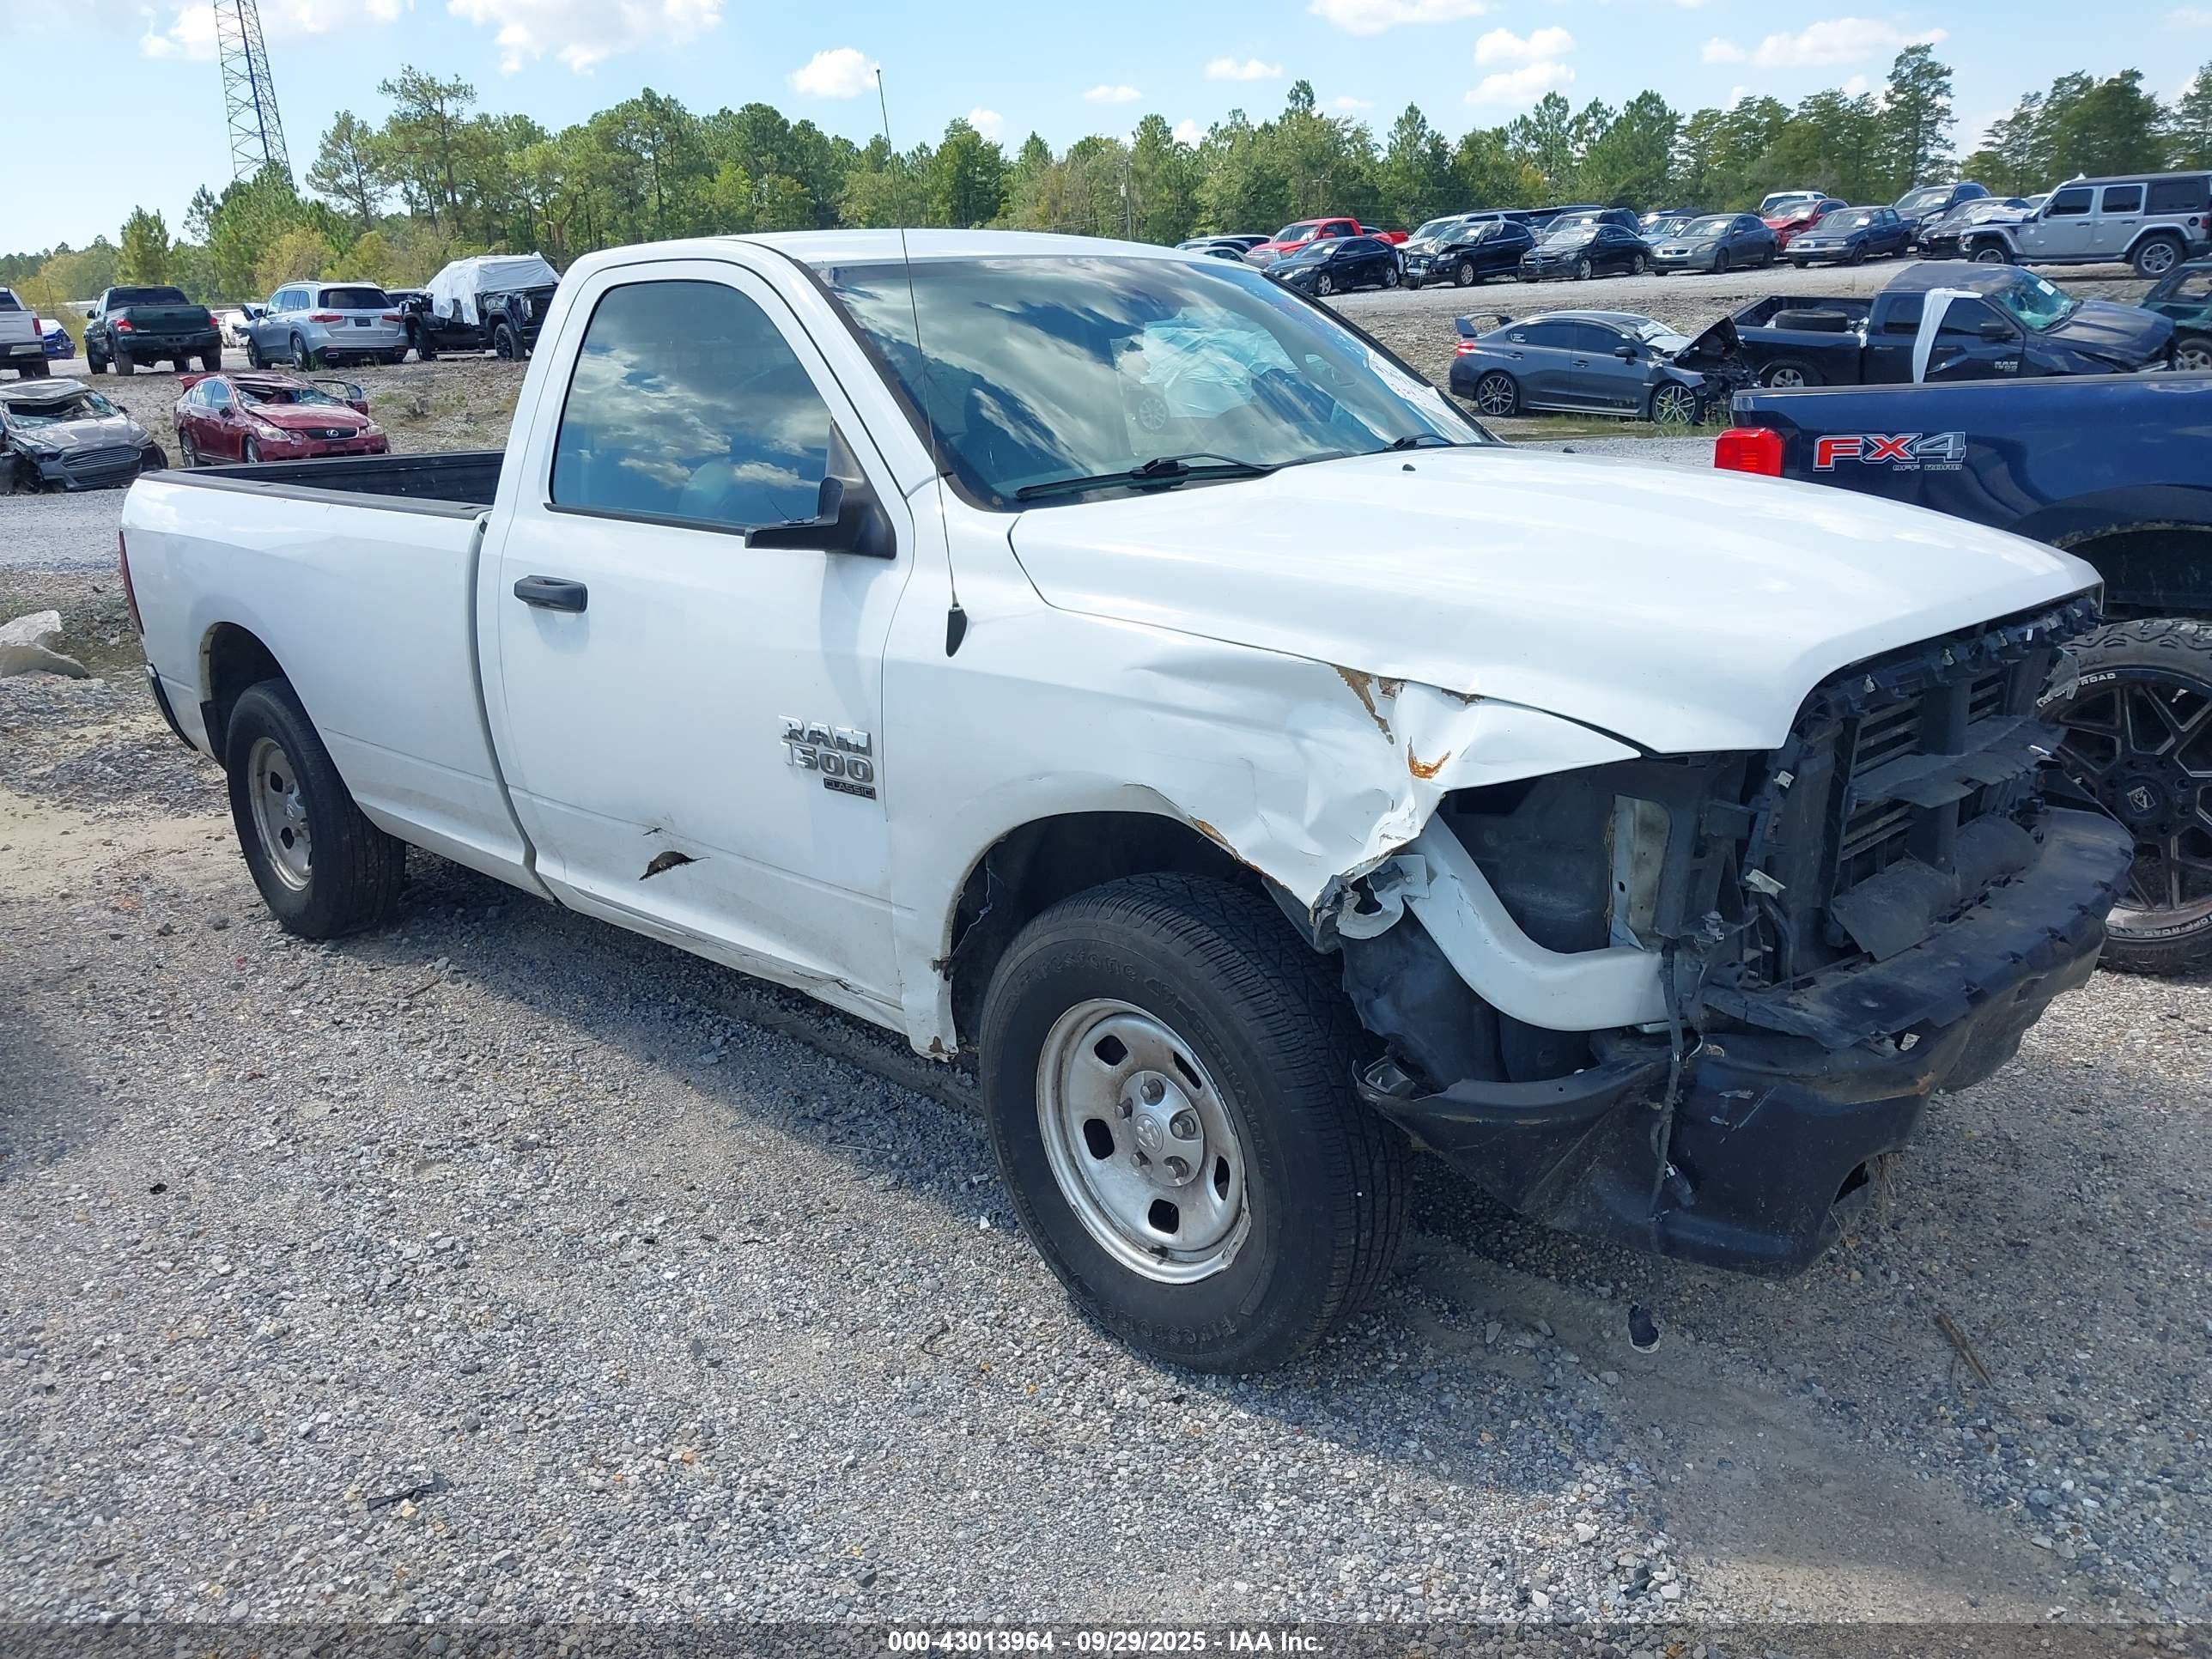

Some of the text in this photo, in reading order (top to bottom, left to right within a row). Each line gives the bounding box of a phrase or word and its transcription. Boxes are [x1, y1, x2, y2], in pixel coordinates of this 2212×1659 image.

[1813, 431, 1966, 472] FX4
[778, 714, 872, 757] RAM
[779, 740, 874, 783] 1500
[824, 779, 873, 799] CLASSIC
